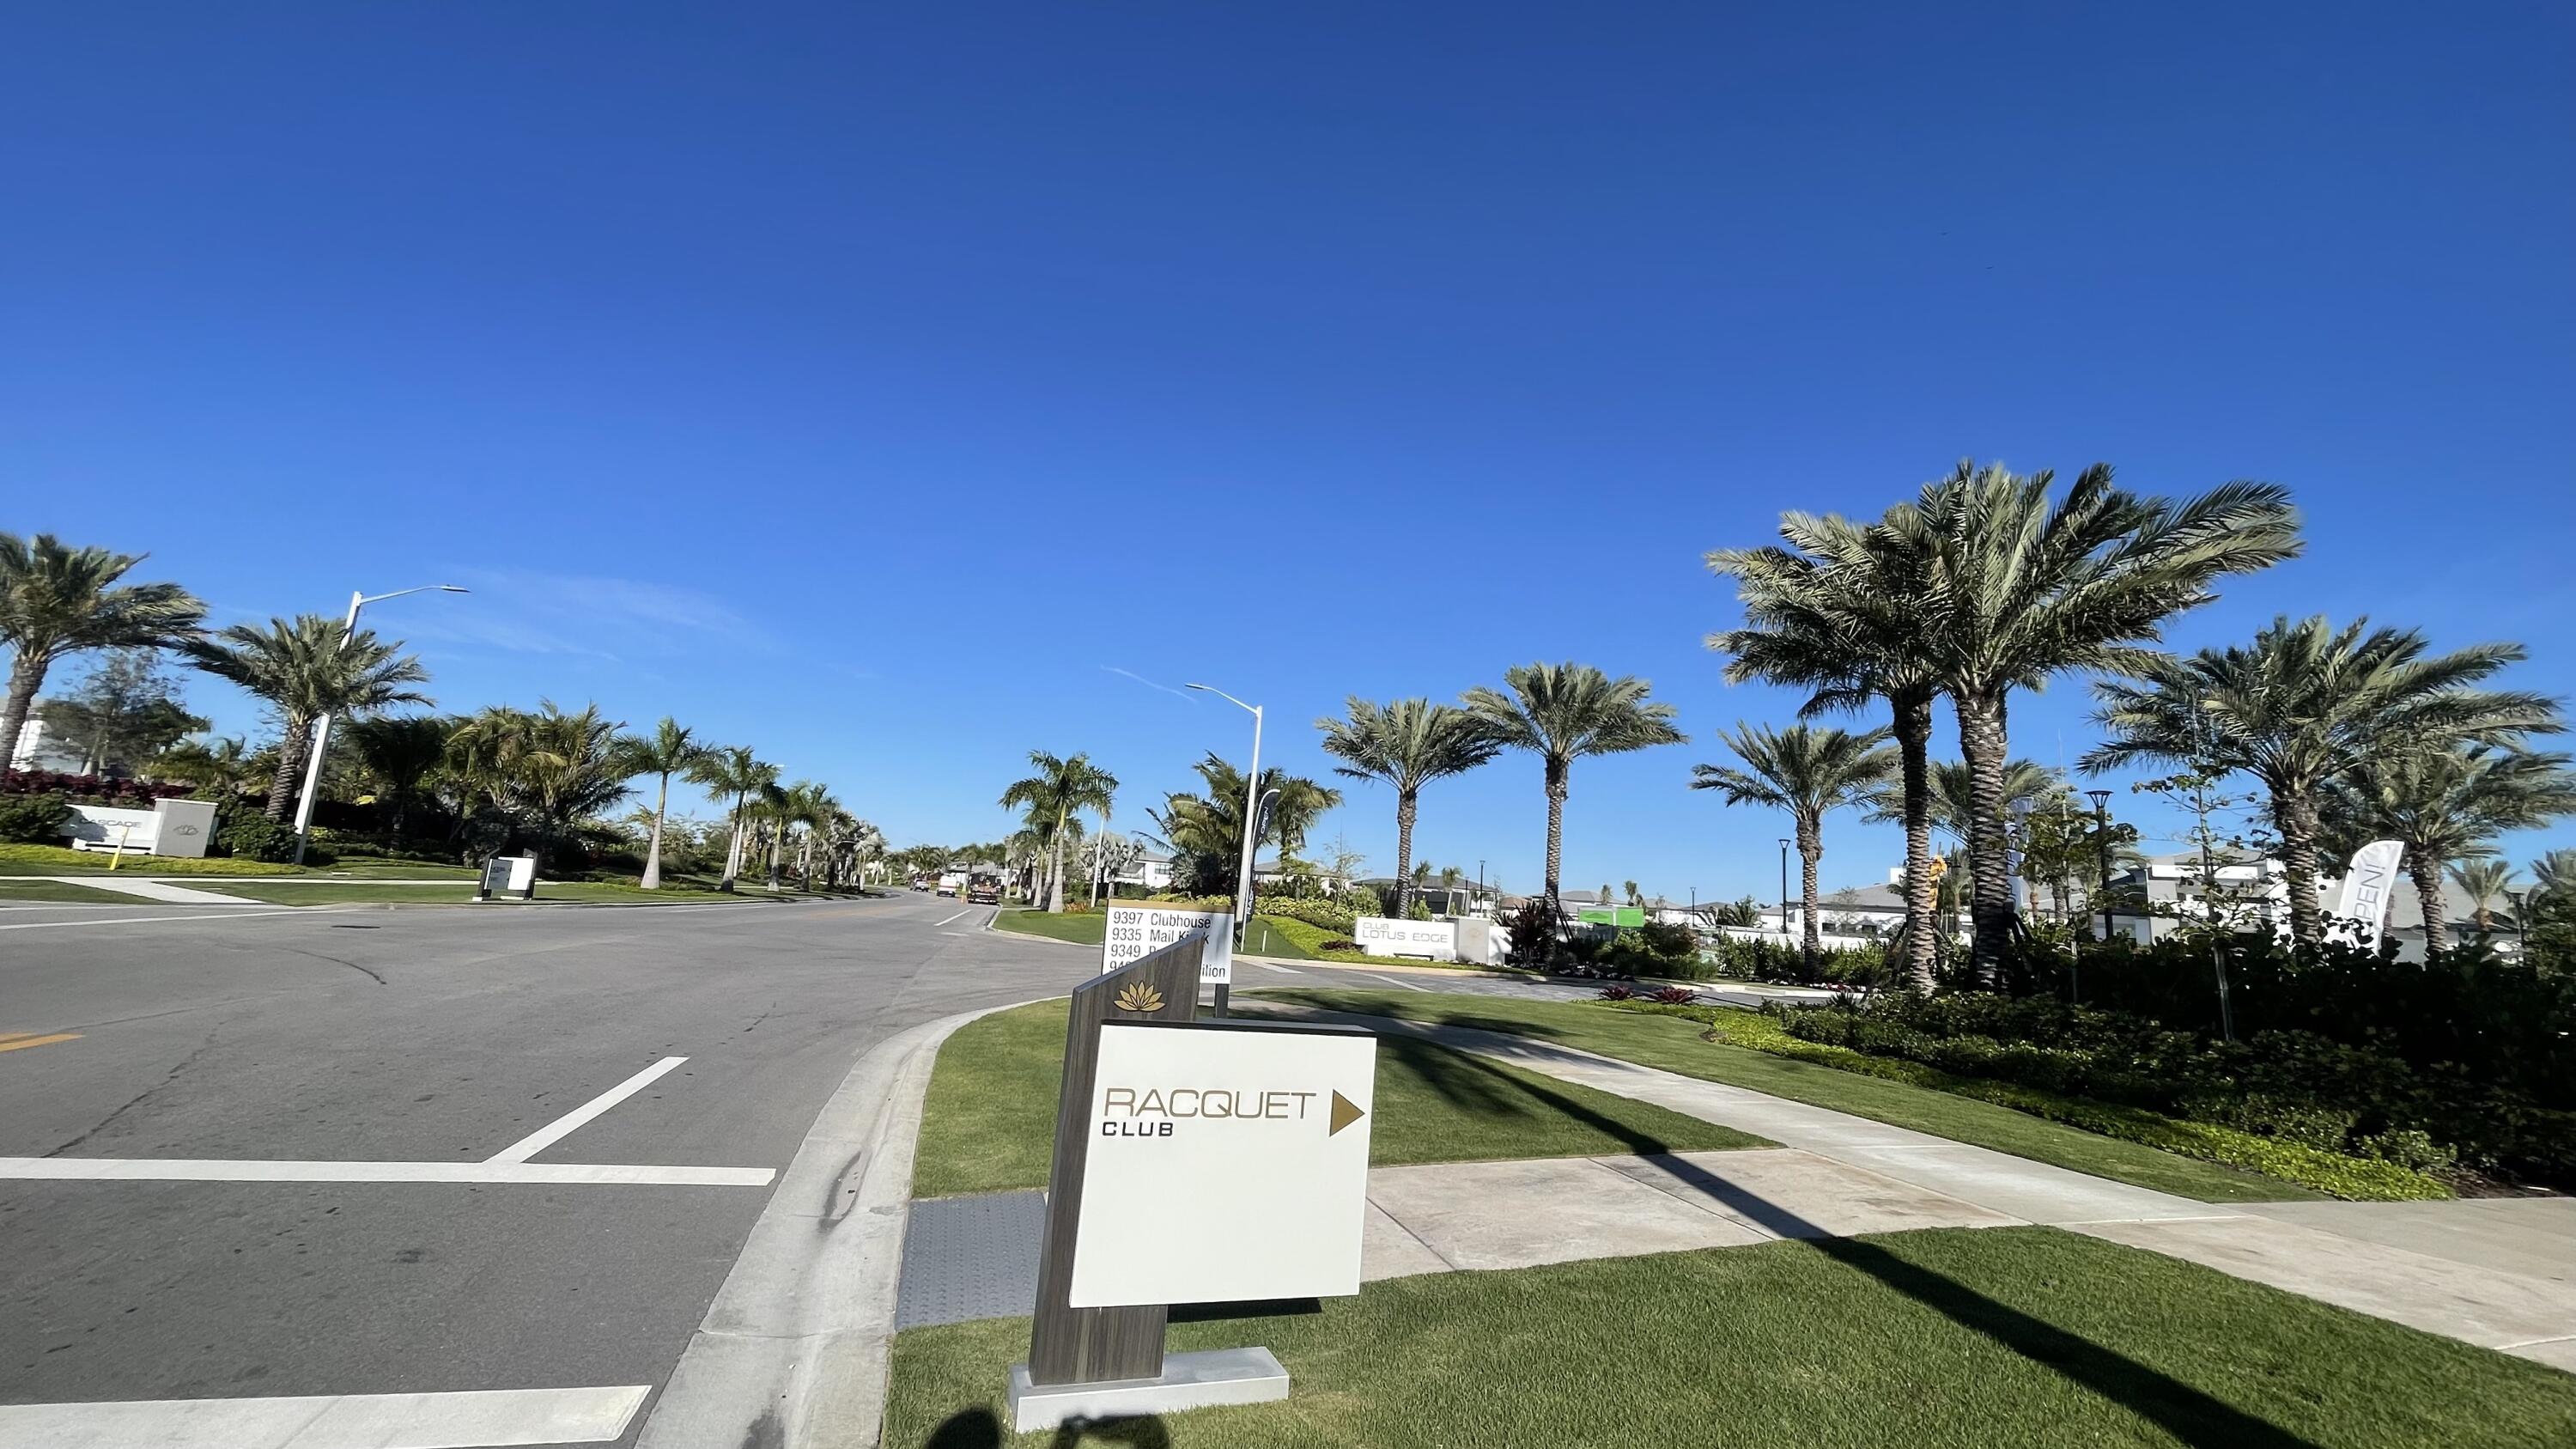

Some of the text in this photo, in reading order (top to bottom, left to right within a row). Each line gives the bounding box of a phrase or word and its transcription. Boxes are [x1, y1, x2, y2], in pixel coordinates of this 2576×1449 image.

[79, 818, 143, 828] CASCADE
[1261, 807, 1269, 834] OPEN
[1113, 910, 1212, 928] 9397 Clubhouse
[1363, 922, 1389, 930] CLUB
[1112, 927, 1142, 941] 9335
[1150, 928, 1175, 943] Mail
[1362, 929, 1449, 943] LOTUS EDGE
[1110, 943, 1141, 958] 9349
[1202, 964, 1226, 978] ilion
[1103, 1087, 1317, 1119] RACQUET
[1102, 1121, 1175, 1137] CLUB
